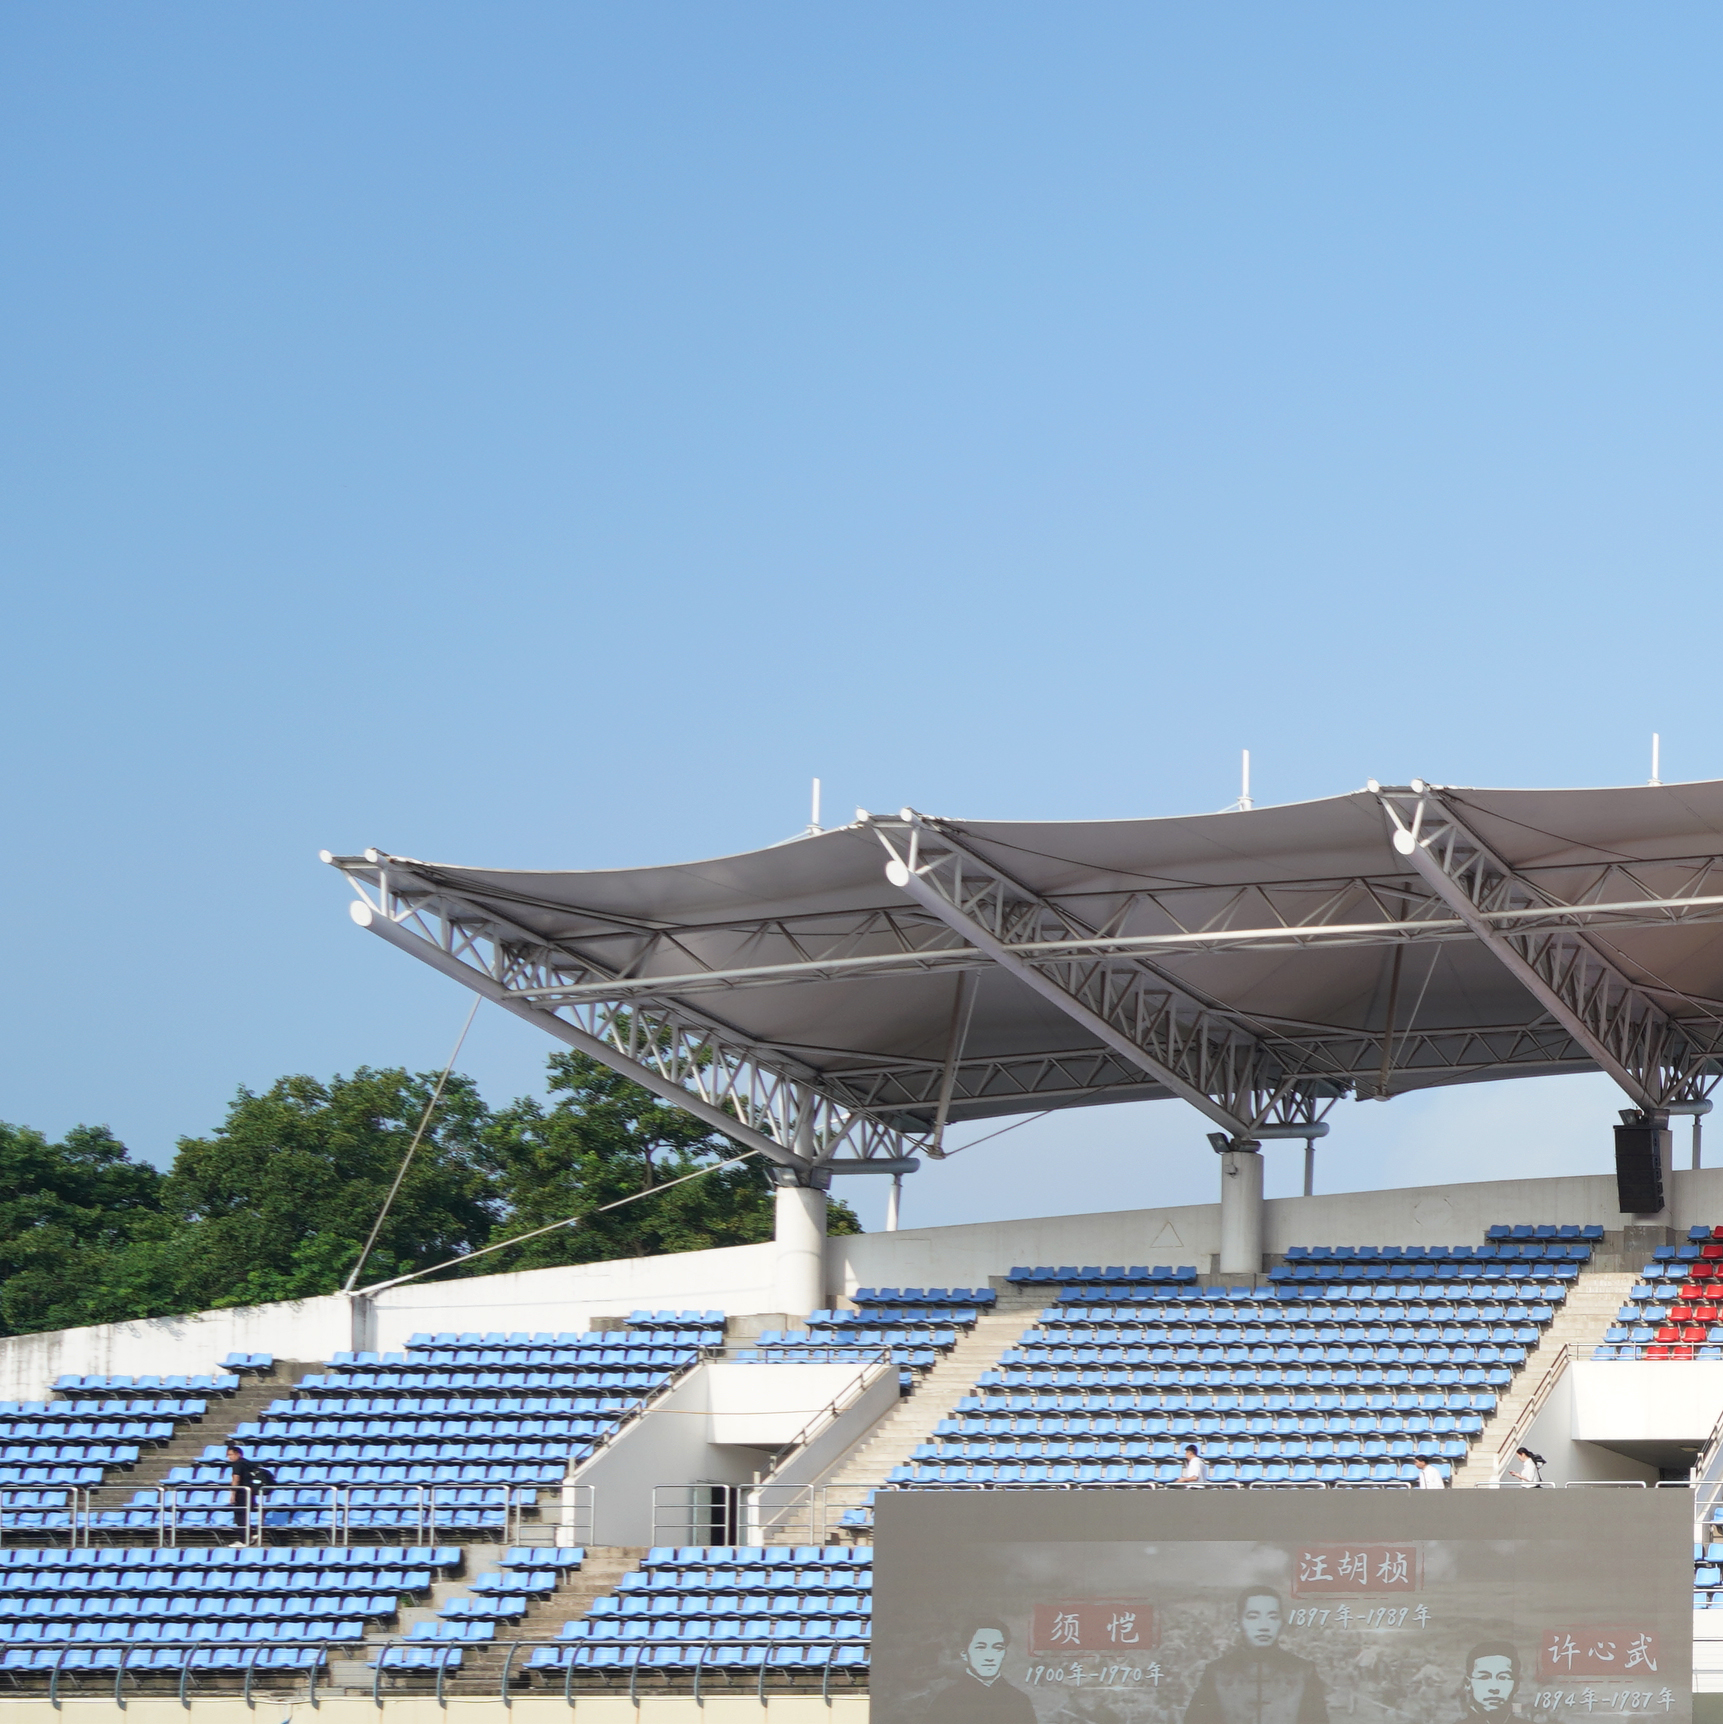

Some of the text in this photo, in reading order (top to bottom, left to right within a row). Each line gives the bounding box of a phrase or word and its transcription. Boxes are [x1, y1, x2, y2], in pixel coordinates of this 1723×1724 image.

[1300, 1550, 1410, 1585] 汪胡桢
[1050, 1611, 1140, 1644] 须恺
[1288, 1603, 1432, 1631] 1897年-1989年
[1549, 1632, 1659, 1672] 许心武
[1025, 1662, 1165, 1689] 1900年-1970年
[1534, 1686, 1676, 1714] 1894年-1987年
